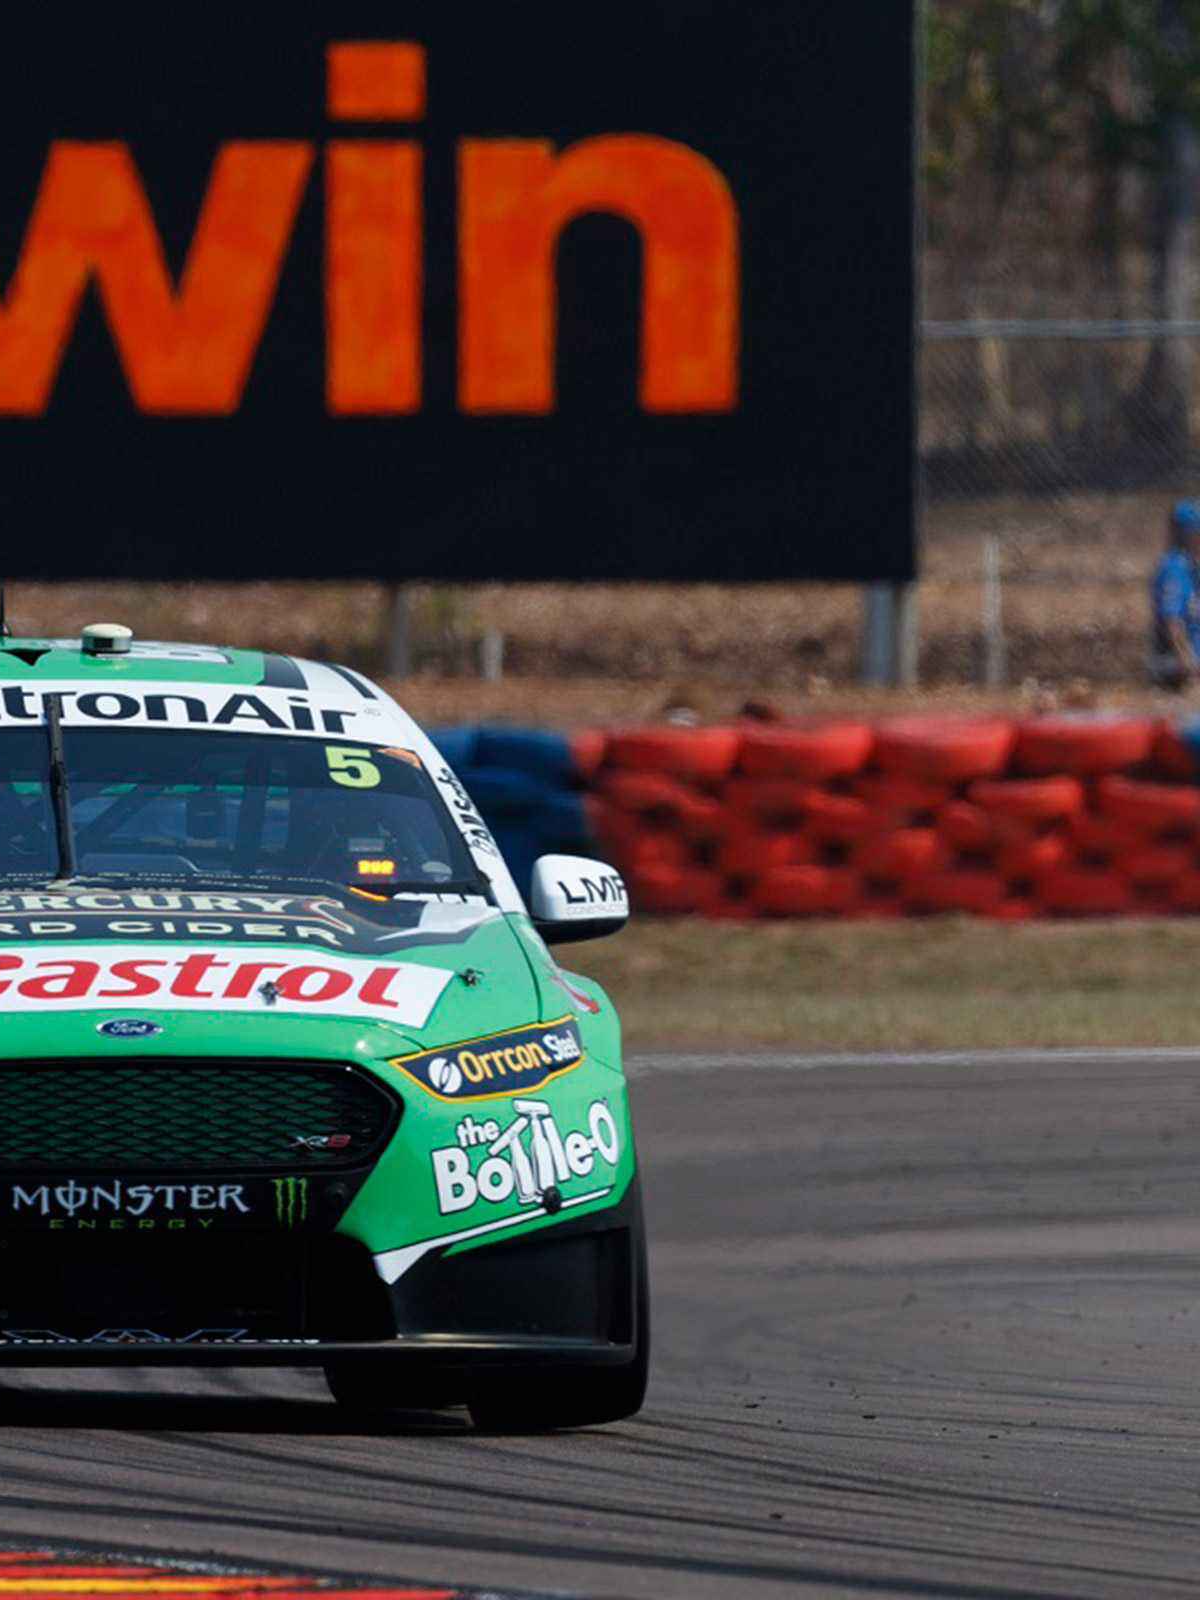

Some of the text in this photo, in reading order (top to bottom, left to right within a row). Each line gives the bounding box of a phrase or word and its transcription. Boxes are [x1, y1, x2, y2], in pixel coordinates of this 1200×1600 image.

[325, 746, 381, 788] 5
[107, 920, 343, 946] CIDER
[458, 1029, 581, 1083] Orrcon Steel
[456, 1115, 500, 1148] the
[11, 1179, 250, 1217] MONSTER
[50, 1219, 214, 1229] ENERGY
